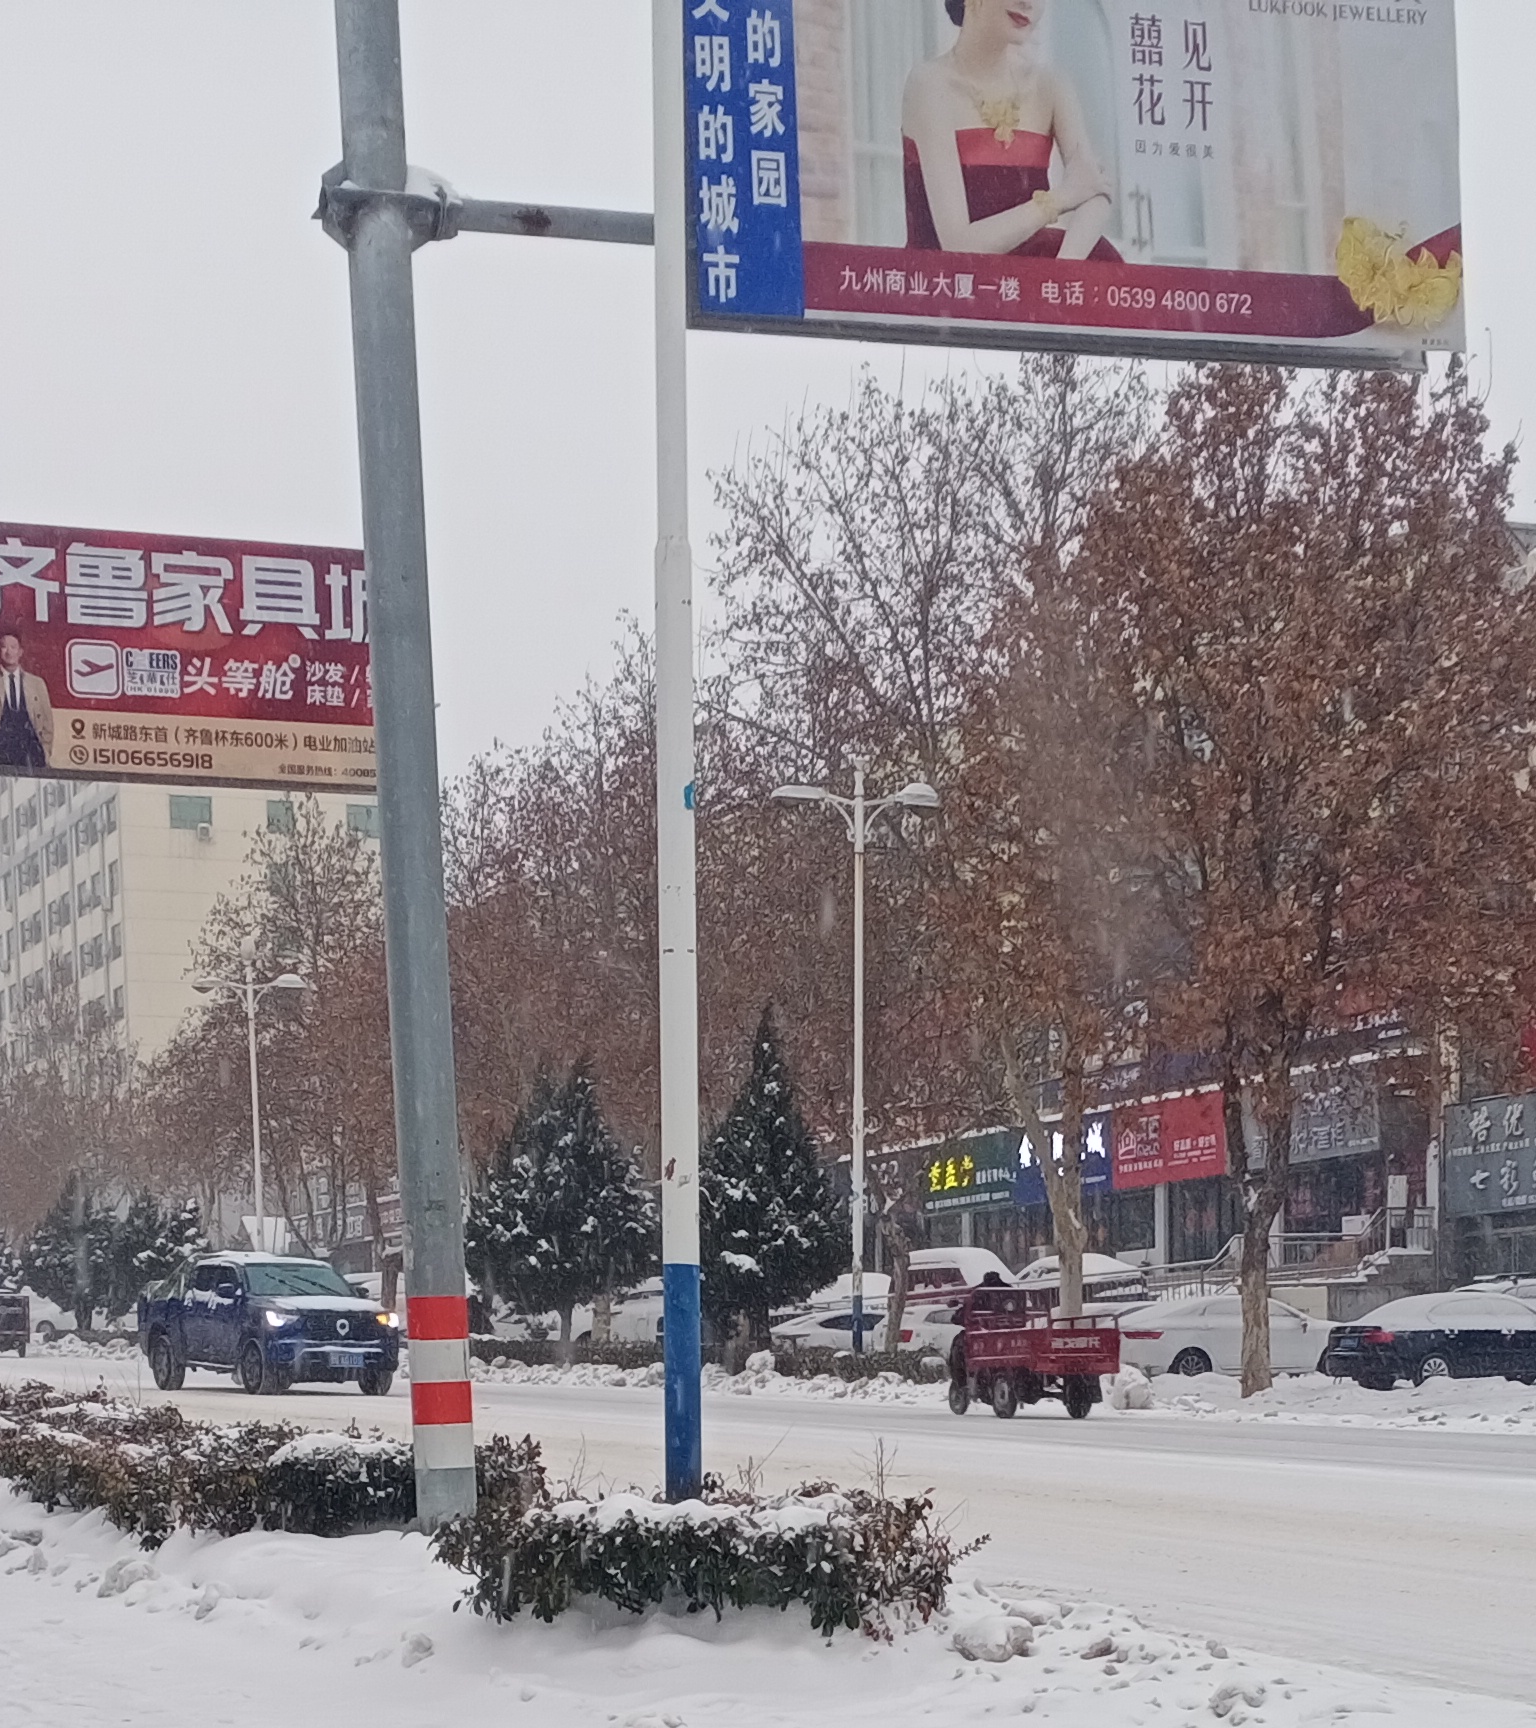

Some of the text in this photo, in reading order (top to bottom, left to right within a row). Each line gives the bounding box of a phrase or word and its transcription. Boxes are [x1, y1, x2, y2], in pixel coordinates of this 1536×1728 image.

[1331, 4, 1428, 26] JEWELLERY
[745, 8, 789, 209] 的家园
[839, 265, 1022, 302] 九州商业大厦一楼
[125, 650, 178, 671] CEERS
[305, 660, 372, 687] 沙发/
[183, 656, 297, 700] 头等舱
[305, 684, 374, 709] 床垫/
[92, 748, 214, 770] 15106656918
